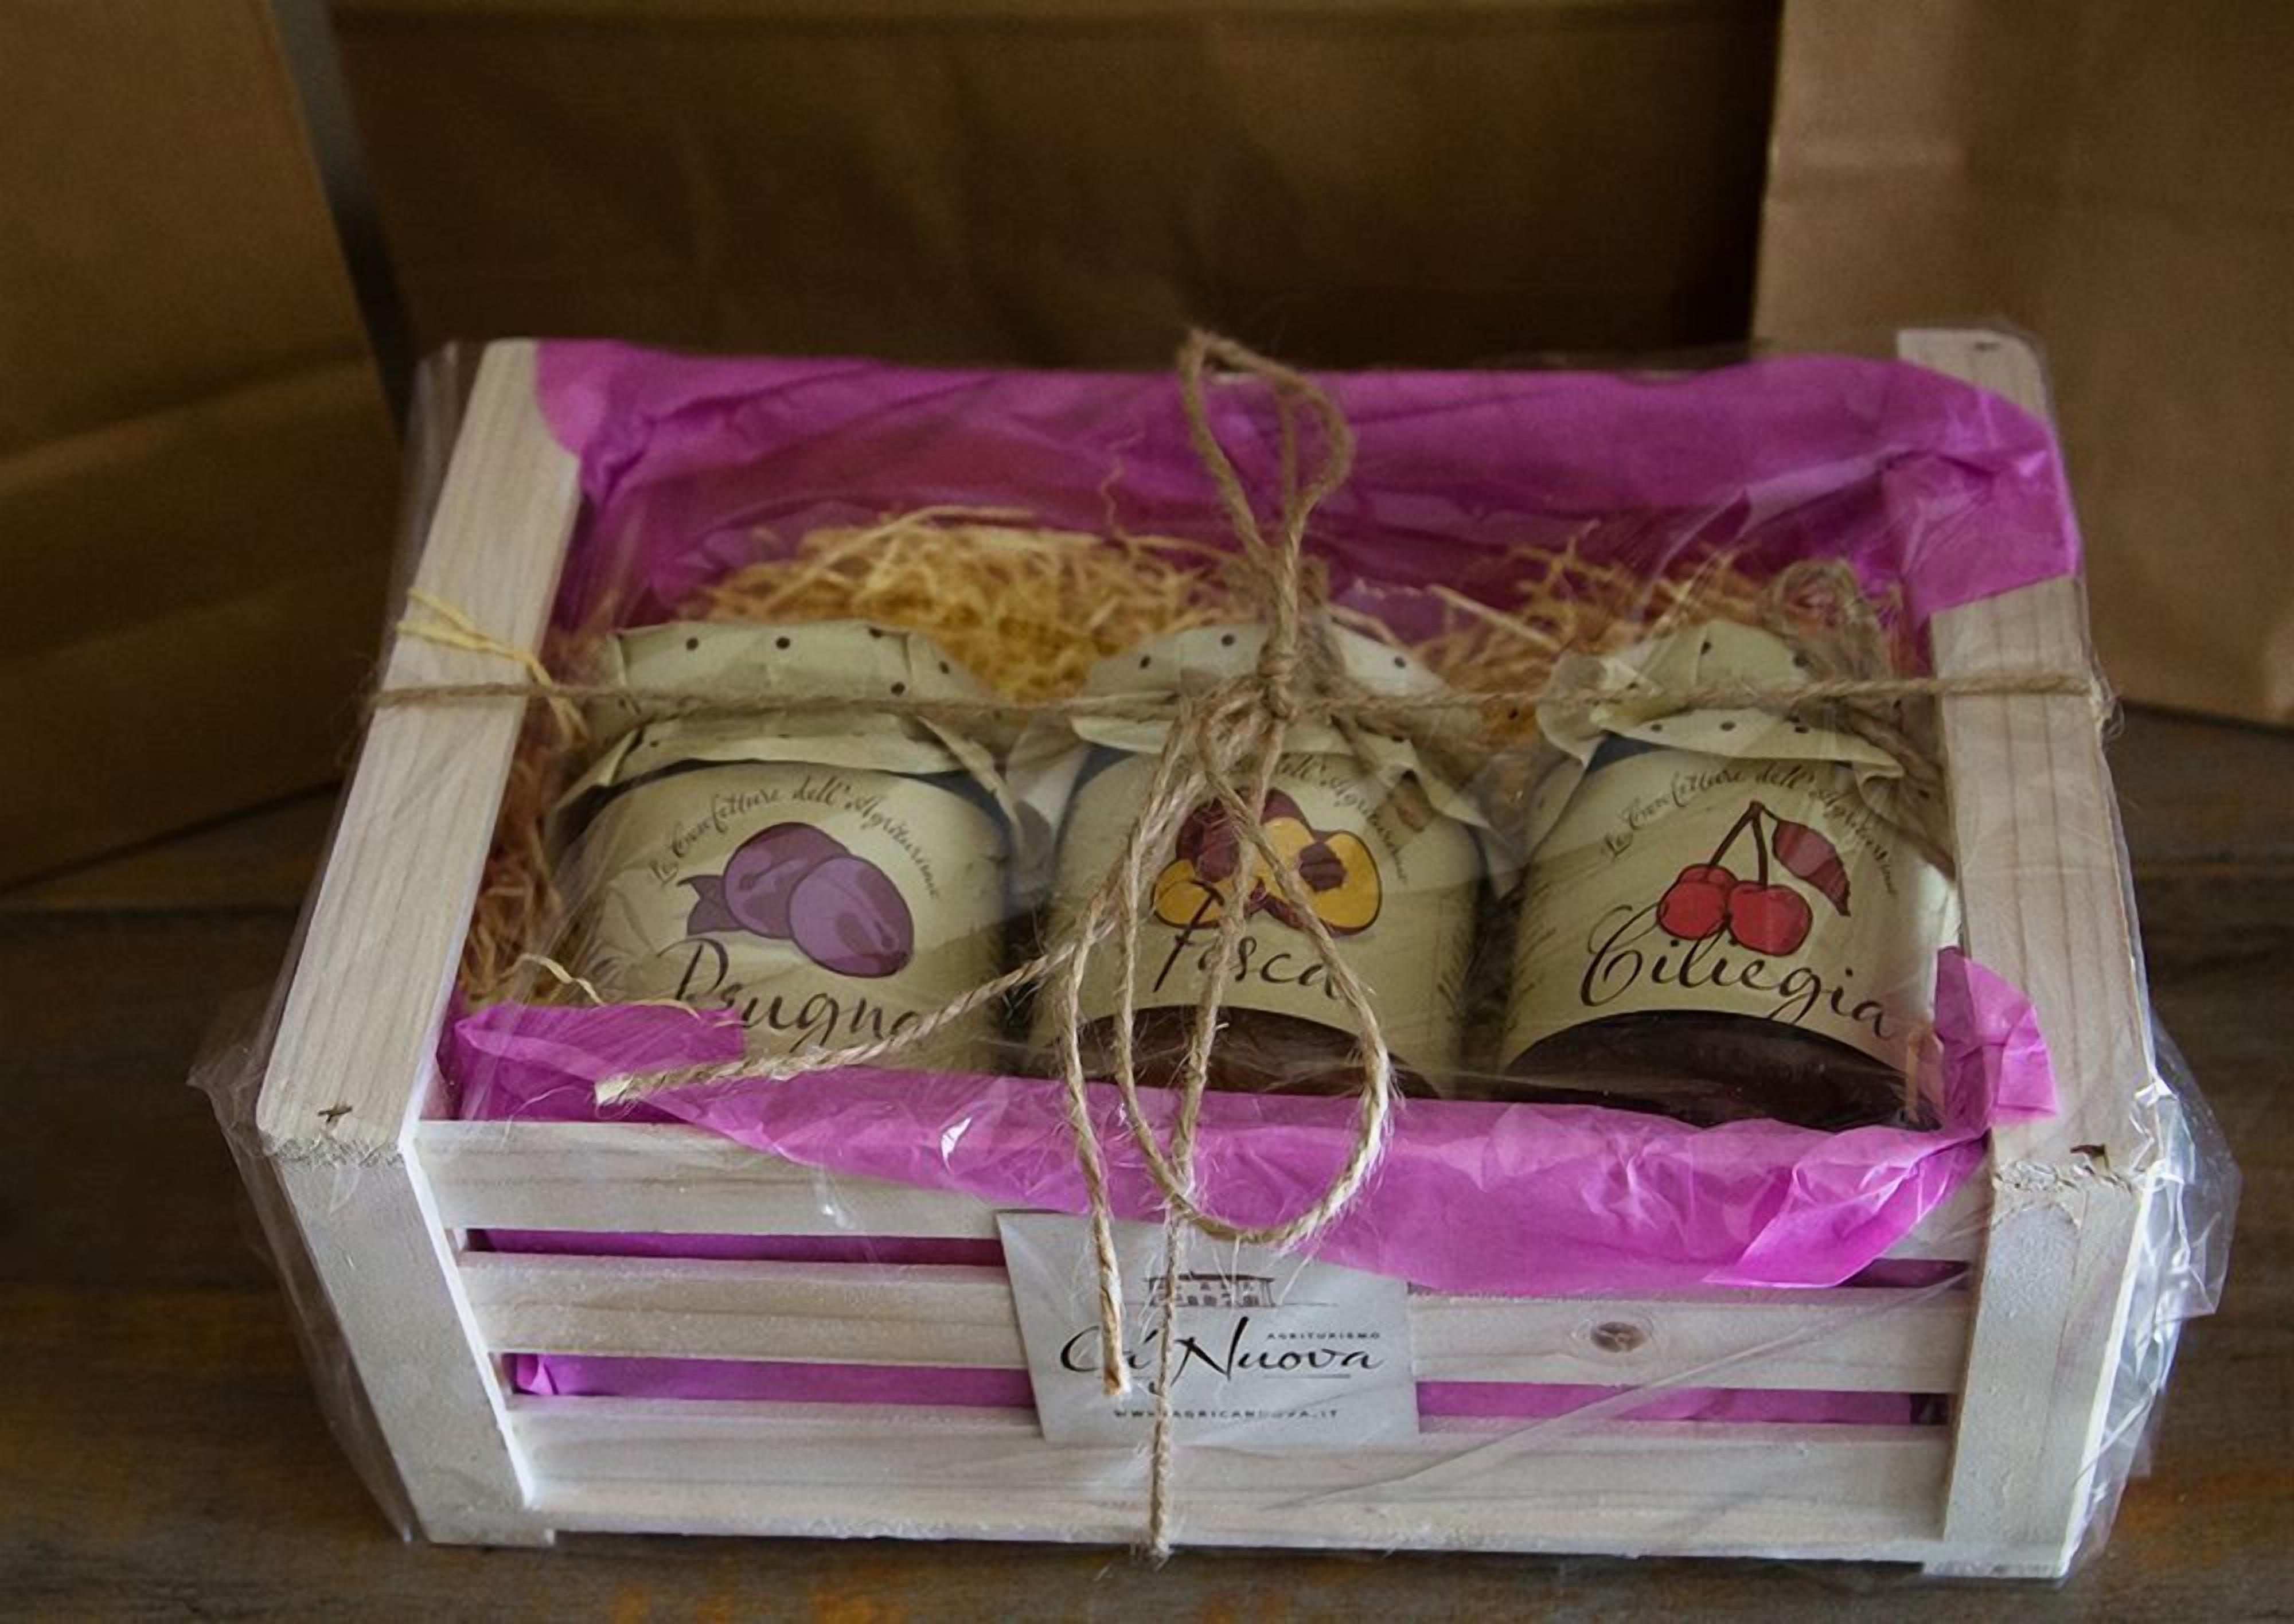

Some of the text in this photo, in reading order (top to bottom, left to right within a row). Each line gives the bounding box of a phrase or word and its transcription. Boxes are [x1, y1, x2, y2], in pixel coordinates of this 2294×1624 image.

[1580, 900, 1895, 1039] Ciliegia
[1149, 1316, 1384, 1397] Nuova
[1266, 1330, 1380, 1341] AGRITURISMO
